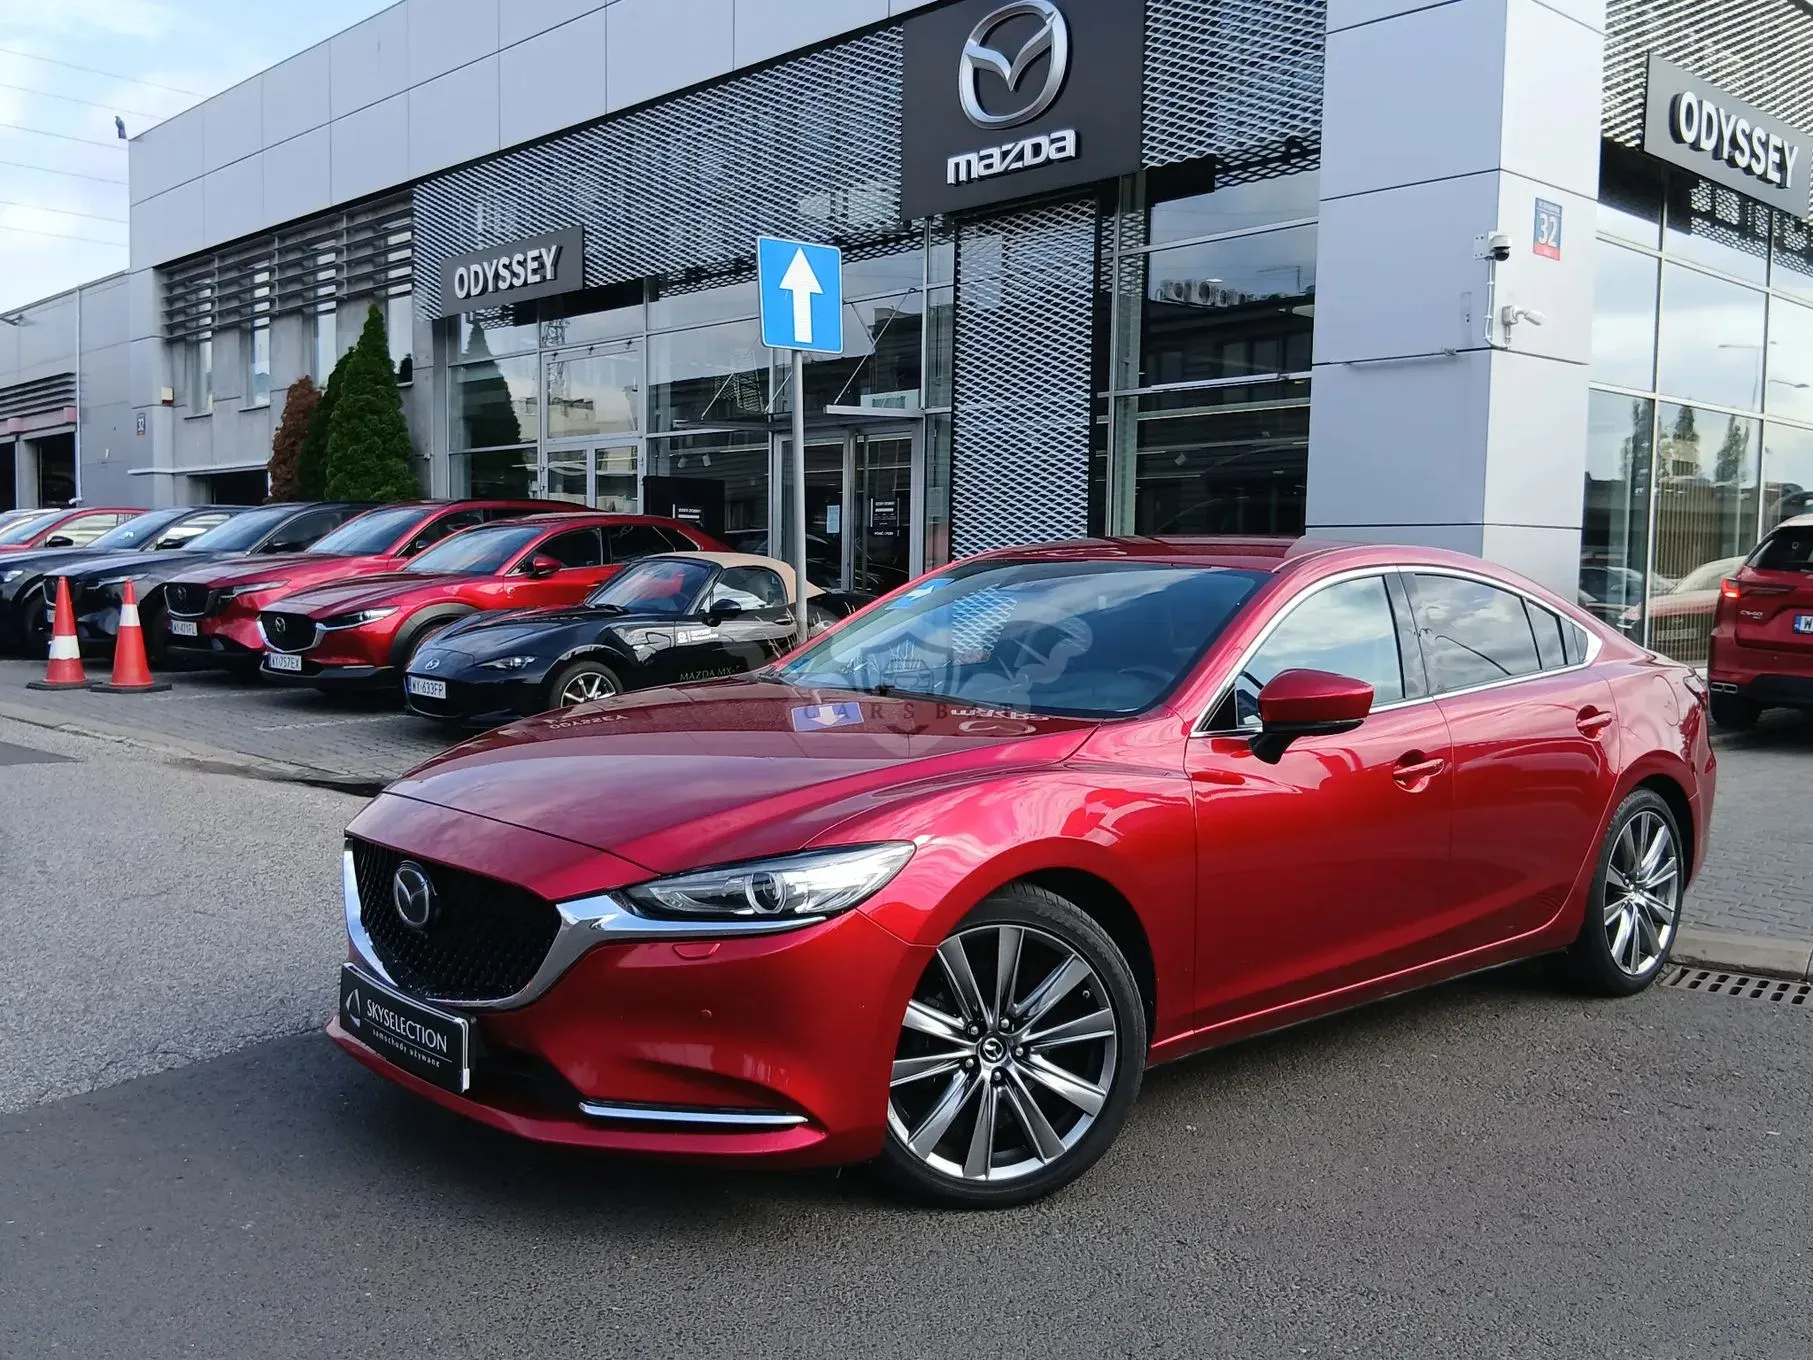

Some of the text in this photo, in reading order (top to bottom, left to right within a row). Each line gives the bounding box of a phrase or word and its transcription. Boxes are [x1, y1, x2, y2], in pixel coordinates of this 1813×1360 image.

[946, 129, 1076, 185] mazda
[1676, 91, 1799, 189] ODYSSEY
[1538, 212, 1557, 247] 32
[454, 244, 558, 299] ODYSSEY
[680, 668, 715, 682] MAZDA
[366, 999, 448, 1053] SKYSELECTION
